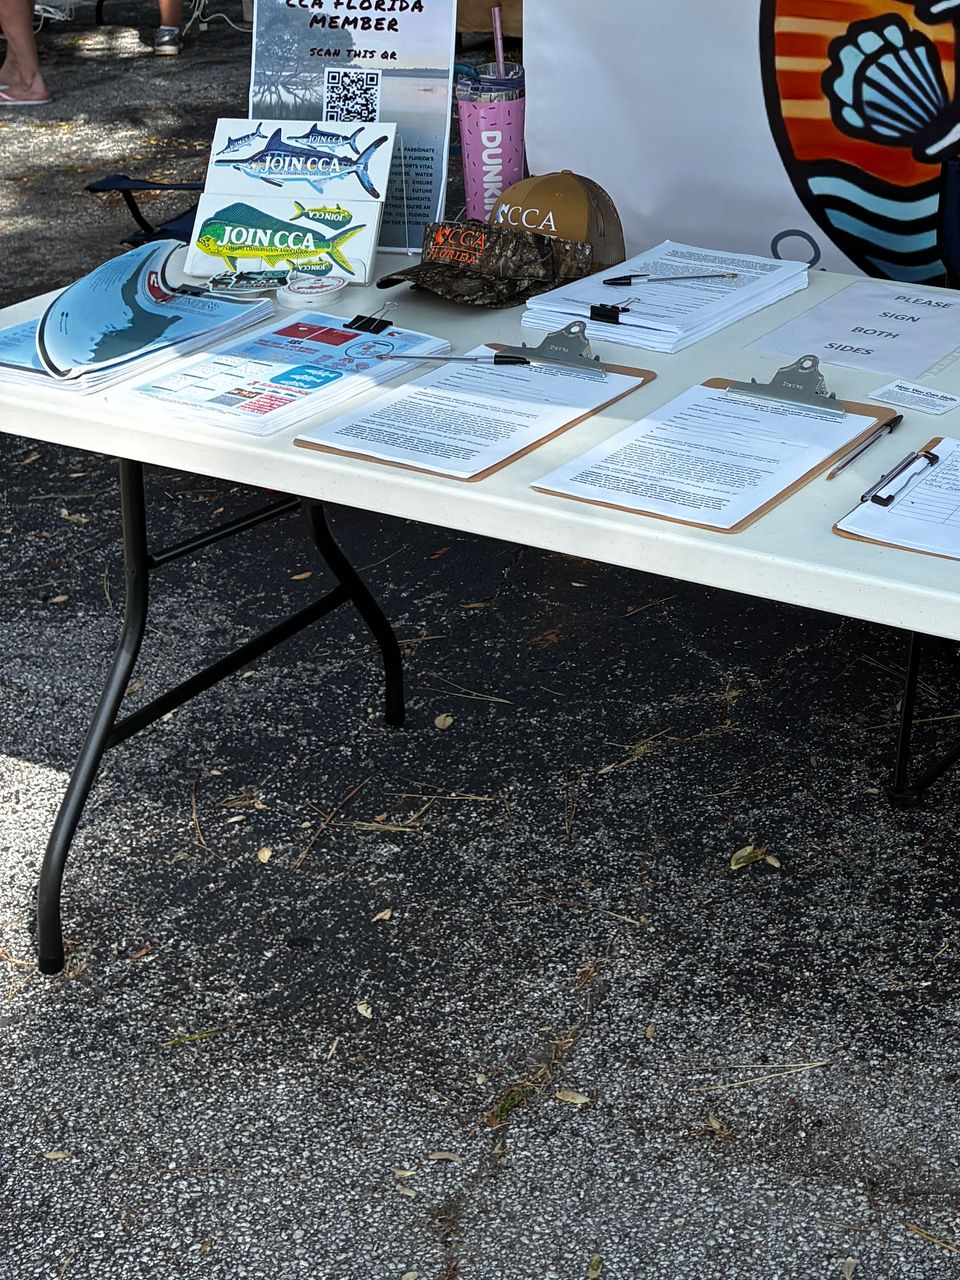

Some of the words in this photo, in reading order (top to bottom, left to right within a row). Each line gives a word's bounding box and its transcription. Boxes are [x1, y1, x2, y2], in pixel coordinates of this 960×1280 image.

[308, 14, 400, 33] MEMBER
[308, 47, 341, 58] SCAN
[346, 48, 377, 59] THIS
[380, 50, 398, 61] QR
[308, 135, 328, 144] JOIN
[328, 136, 344, 144] CCA
[261, 156, 305, 175] JOIN
[306, 158, 341, 173] CCA
[308, 211, 325, 219] CCA
[325, 212, 344, 222] JOIN
[507, 206, 558, 232] CCA
[217, 226, 273, 249] JOIN
[273, 231, 316, 250] CCA
[447, 228, 487, 251] CCA
[895, 294, 954, 310] PLEASE
[877, 310, 922, 324] SIGN
[850, 325, 901, 340] BOTH
[824, 341, 875, 356] SIDES
